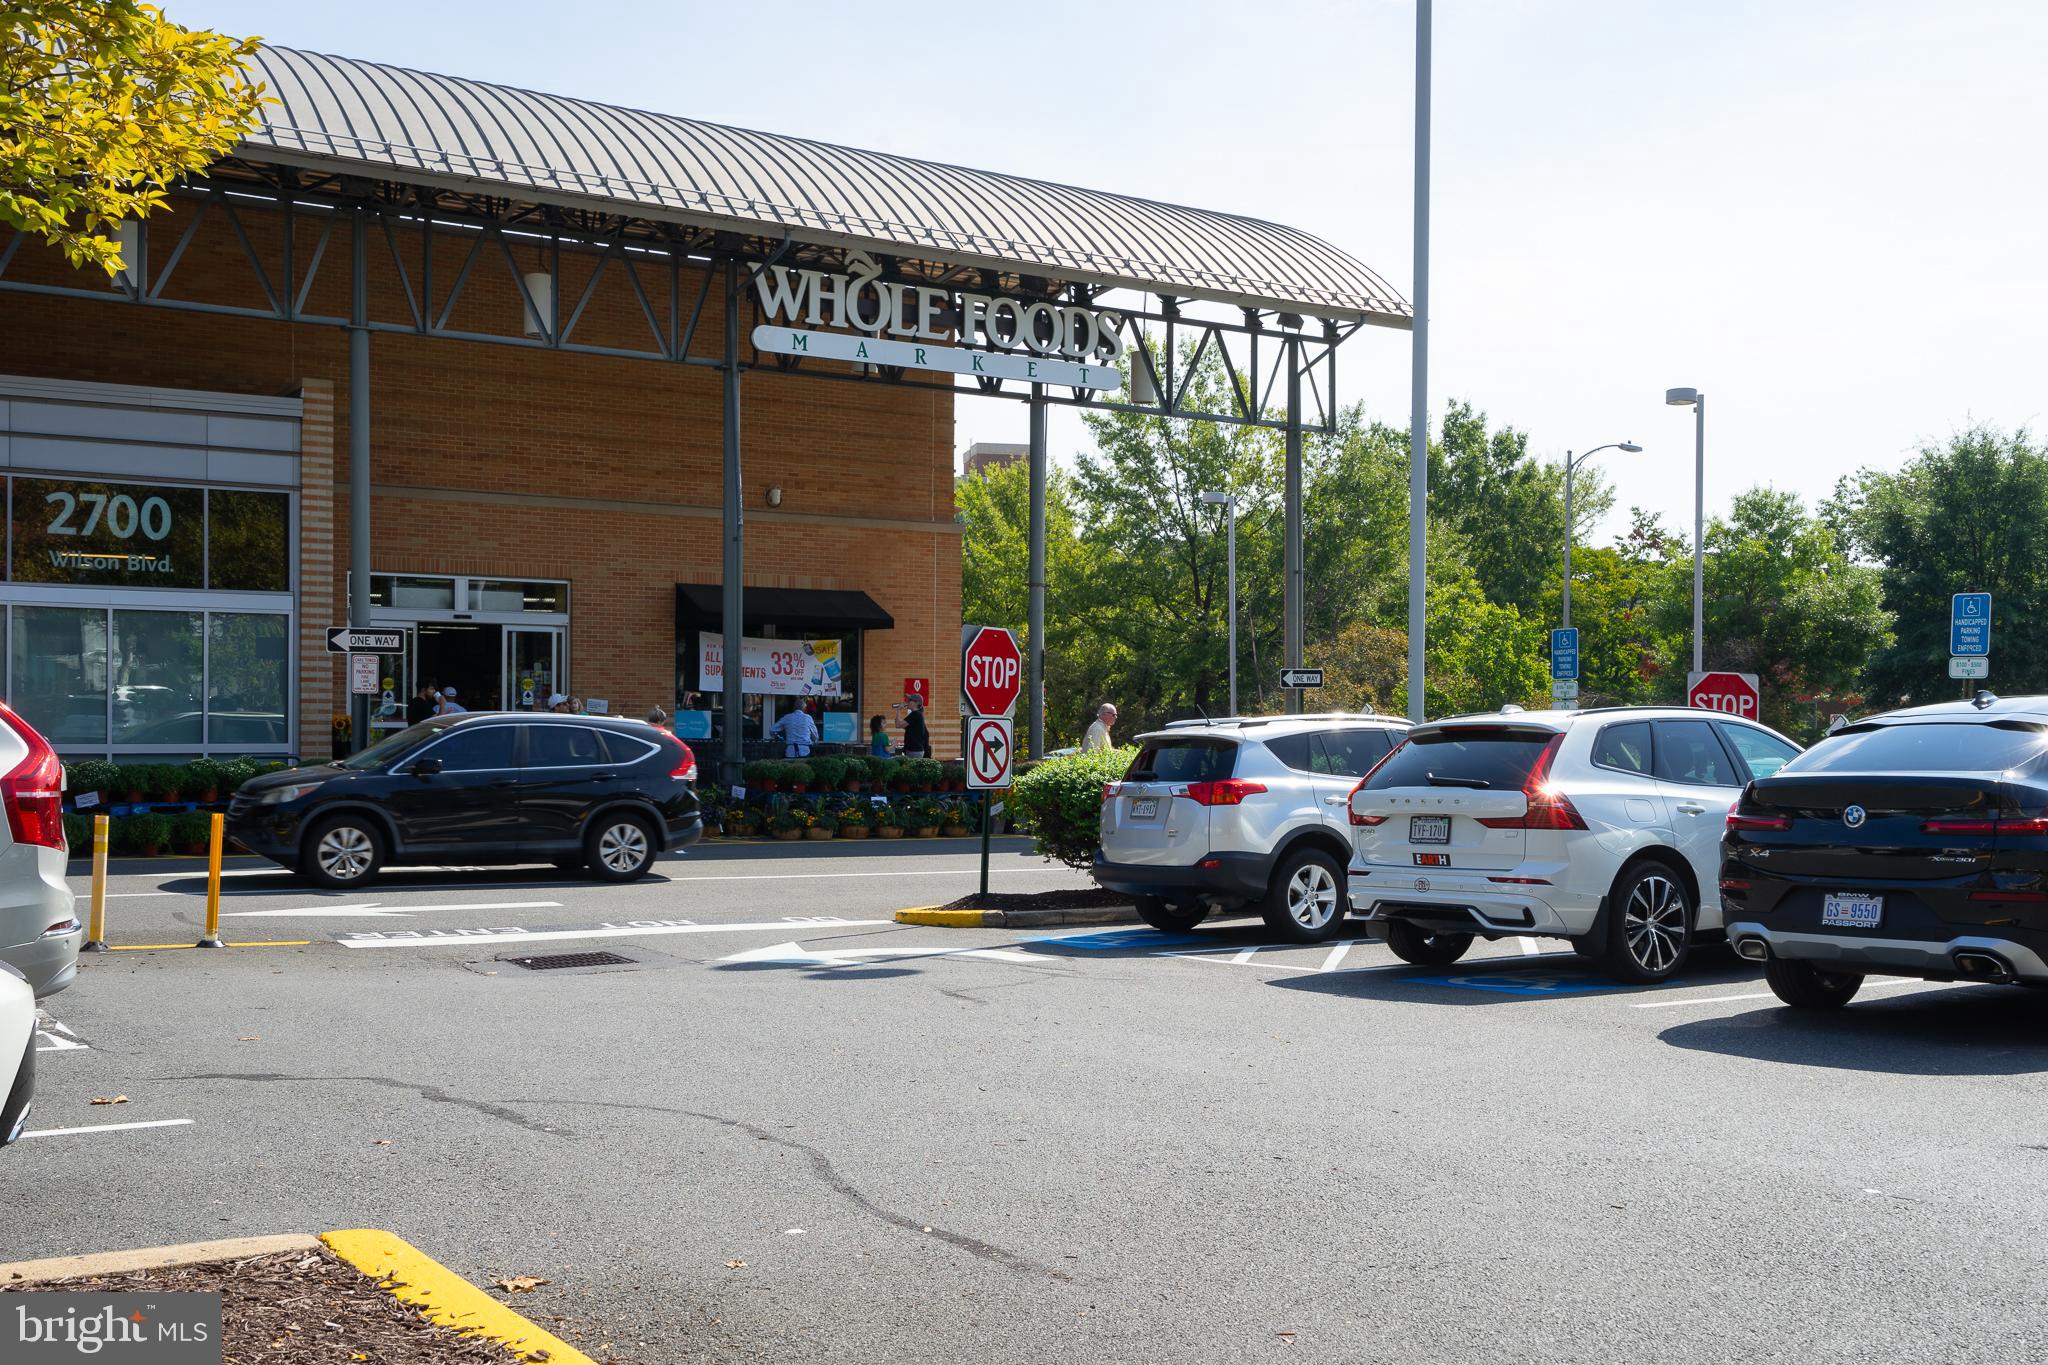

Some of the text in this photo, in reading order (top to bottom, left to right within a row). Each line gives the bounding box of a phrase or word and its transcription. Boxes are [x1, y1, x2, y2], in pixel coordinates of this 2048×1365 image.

[747, 252, 1124, 361] WHOLE FOODS
[791, 332, 1091, 384] MARKET
[45, 491, 172, 540] 2700
[48, 550, 174, 573] Wilson Blvd.
[1954, 618, 1987, 626] HANDICAPPED
[350, 636, 396, 646] ONE WAY
[704, 651, 721, 663] ALL
[770, 651, 805, 676] 33%
[704, 664, 767, 679] SUPENTS
[794, 669, 804, 677] OFF
[969, 655, 1018, 689] STOP
[1292, 674, 1319, 683] ONE WAY
[1694, 693, 1754, 717] STOP
[1416, 854, 1447, 865] EARTH
[1749, 849, 1770, 857] X4
[1826, 902, 1878, 919] GS 9550
[1822, 919, 1878, 928] PASSPORT
[345, 926, 529, 939] ENTER
